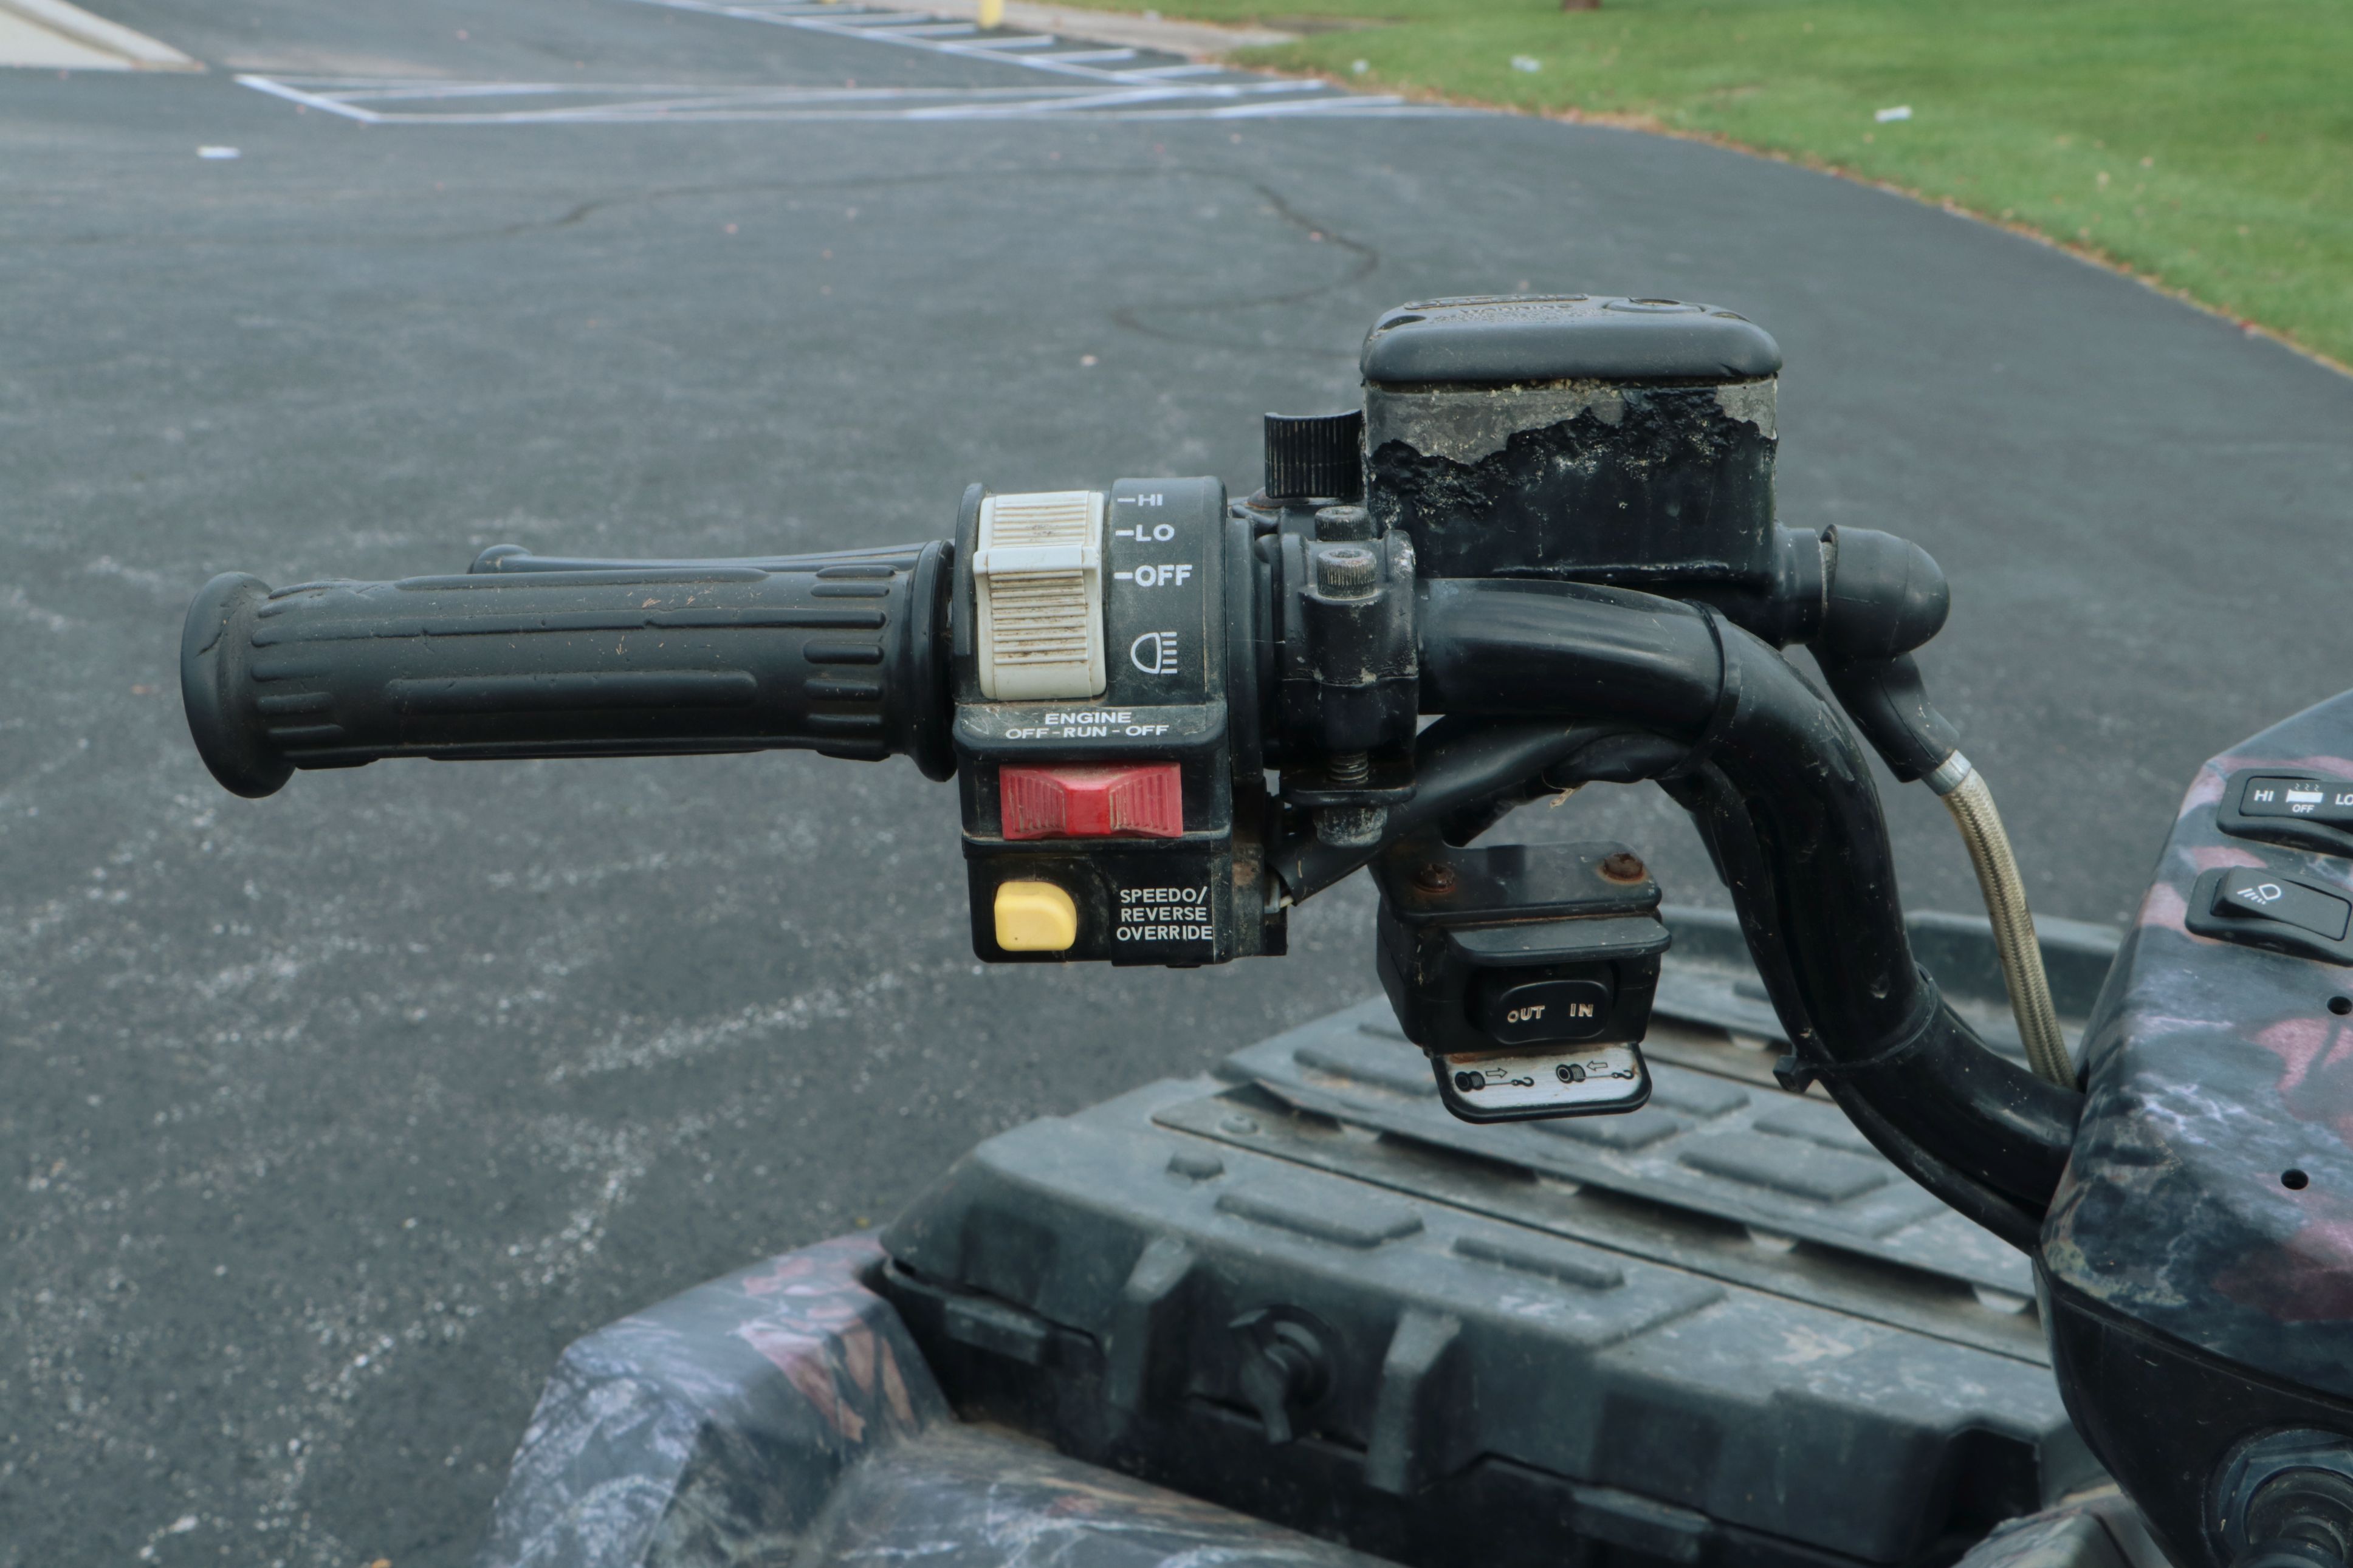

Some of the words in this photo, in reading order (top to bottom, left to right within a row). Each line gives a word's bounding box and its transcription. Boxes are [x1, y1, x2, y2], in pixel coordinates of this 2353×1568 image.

[1135, 564, 1193, 587] OFF
[1045, 711, 1132, 725] ENGINE
[2253, 790, 2275, 802] HI
[2335, 793, 2353, 806] LO
[2292, 803, 2315, 813] OFF
[1120, 886, 1208, 905] SPEEDO/
[1121, 906, 1207, 922] REVERSE
[1116, 925, 1214, 942] OVERRIDE
[1507, 1005, 1545, 1023] OUT
[1570, 1003, 1593, 1018] IN
